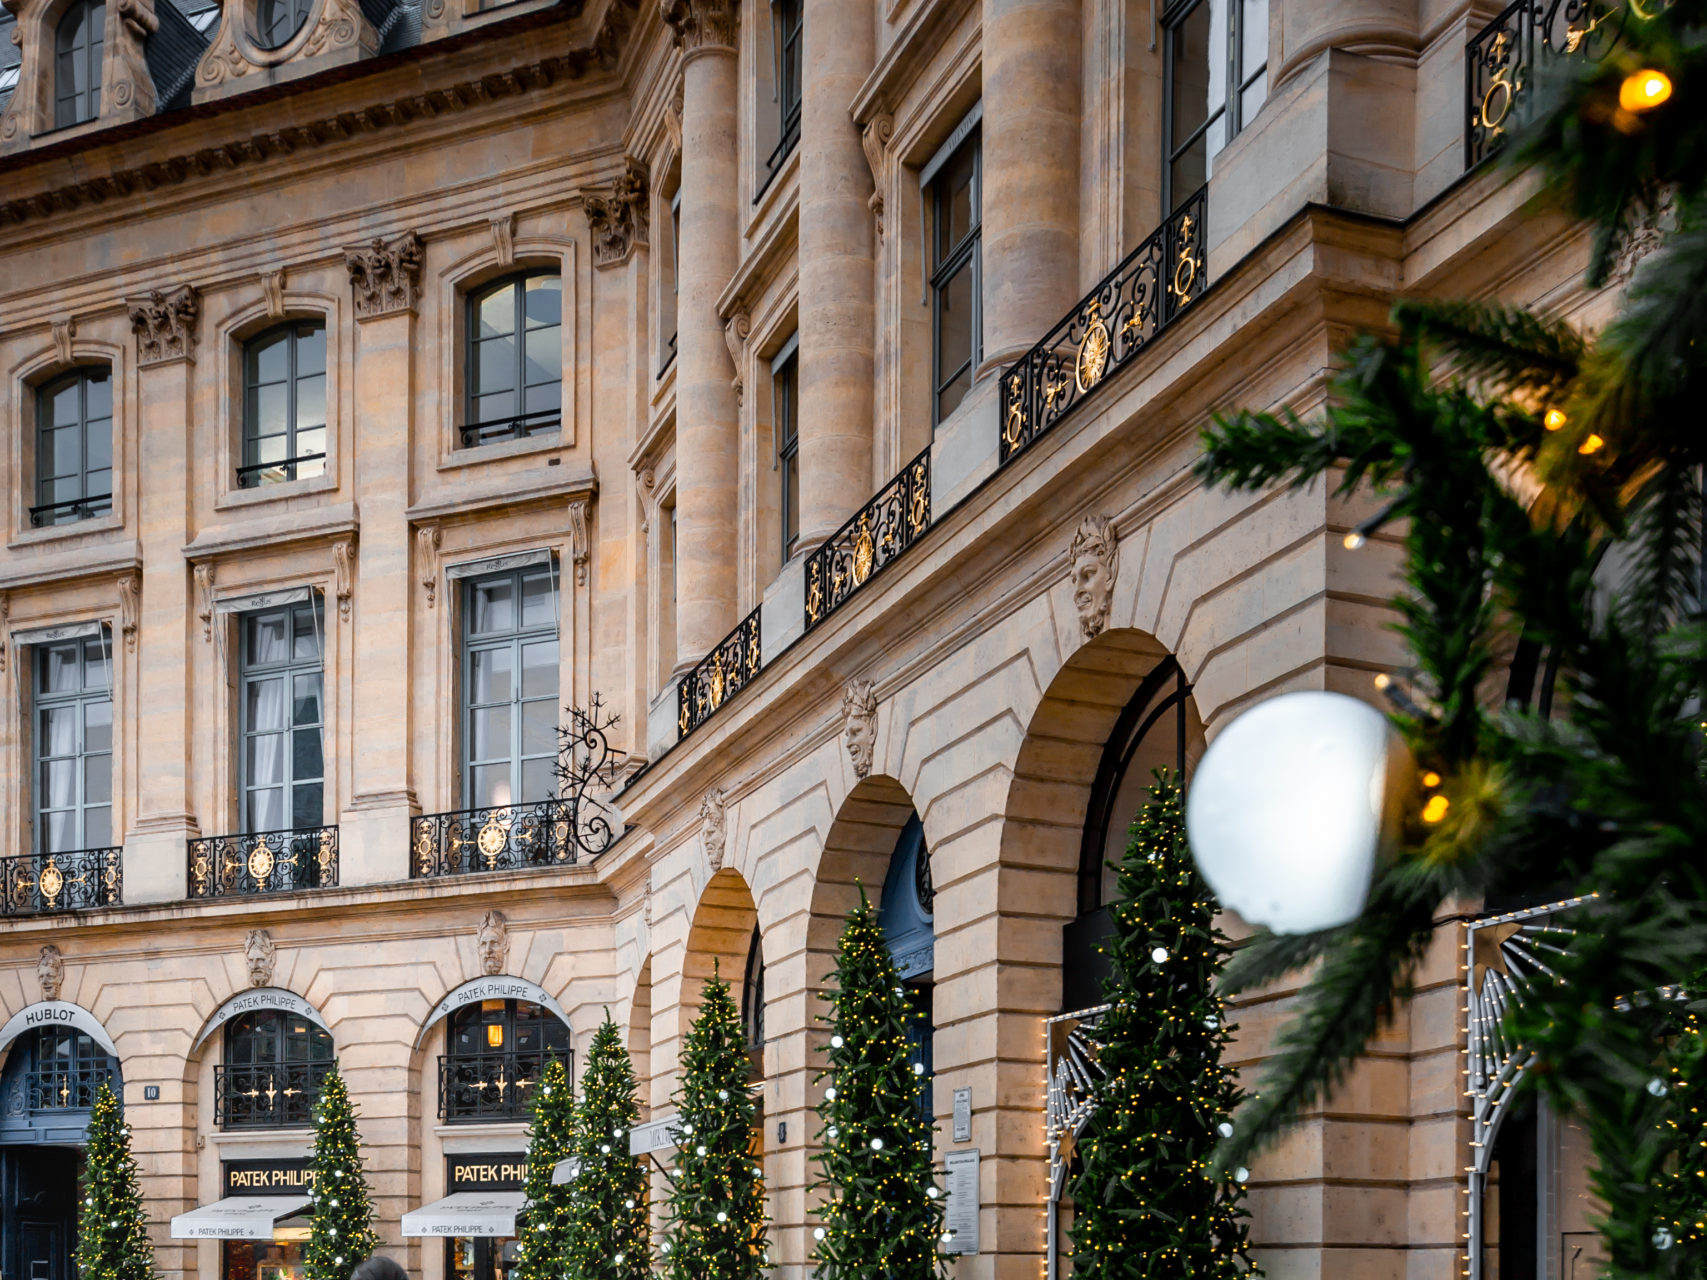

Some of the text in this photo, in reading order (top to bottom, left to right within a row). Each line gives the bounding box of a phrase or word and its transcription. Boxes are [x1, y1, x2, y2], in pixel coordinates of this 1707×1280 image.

[458, 984, 528, 1002] PATEK PHILIPPE
[233, 995, 297, 1012] PATEK PHILIPPE
[26, 1008, 76, 1026] HUBLOT
[146, 1087, 157, 1098] 10
[230, 1171, 270, 1187] PATEK
[455, 1165, 499, 1182] PATEK
[198, 1228, 244, 1236] PATEK PHILIPPE
[432, 1225, 483, 1234] PATEK PHILIPPE
